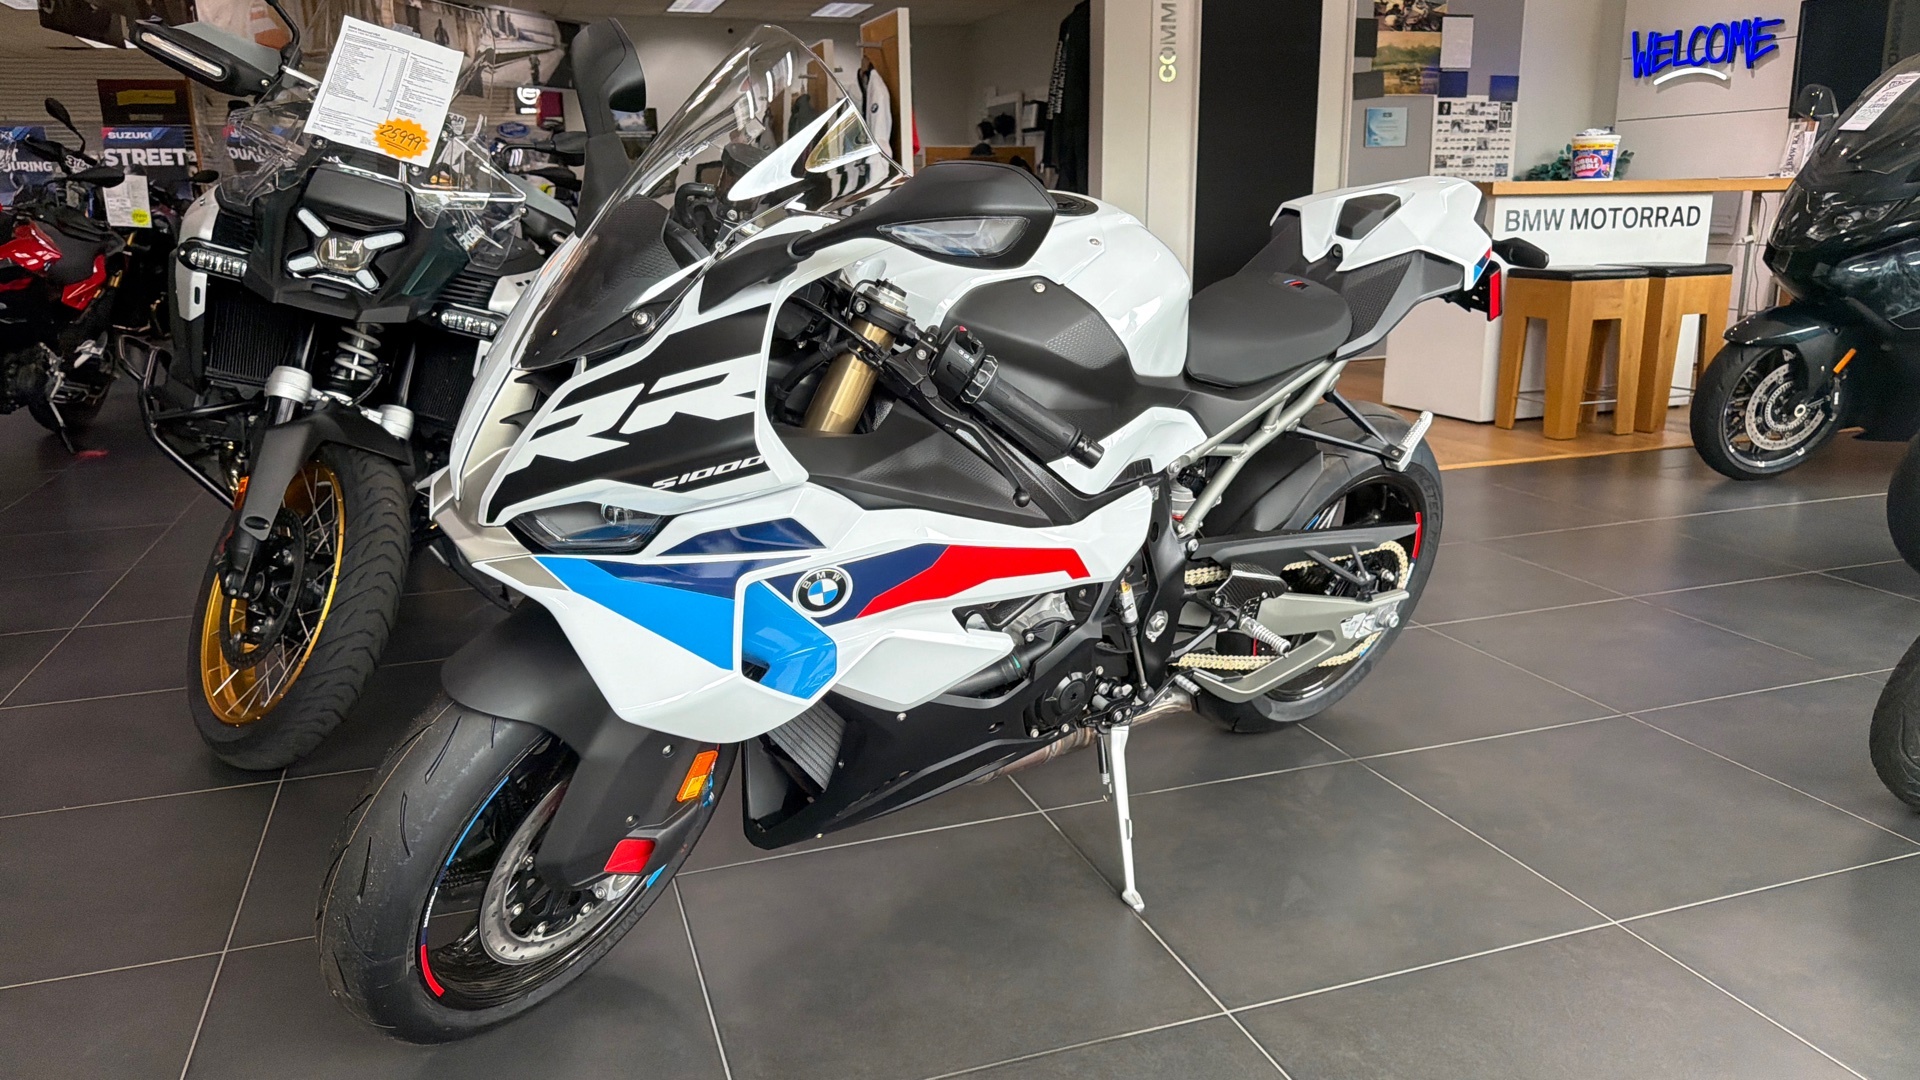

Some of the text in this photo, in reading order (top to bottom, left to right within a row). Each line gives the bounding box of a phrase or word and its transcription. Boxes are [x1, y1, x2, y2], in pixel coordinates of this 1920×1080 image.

[1158, 0, 1176, 83] COMM
[1631, 17, 1784, 79] WELCOME
[107, 131, 153, 140] SUZUKI
[1, 161, 53, 173] OURING
[104, 148, 186, 167] STREET
[1505, 206, 1701, 232] BMW MOTORRAD
[652, 455, 765, 490] S1000
[801, 571, 843, 590] BMW
